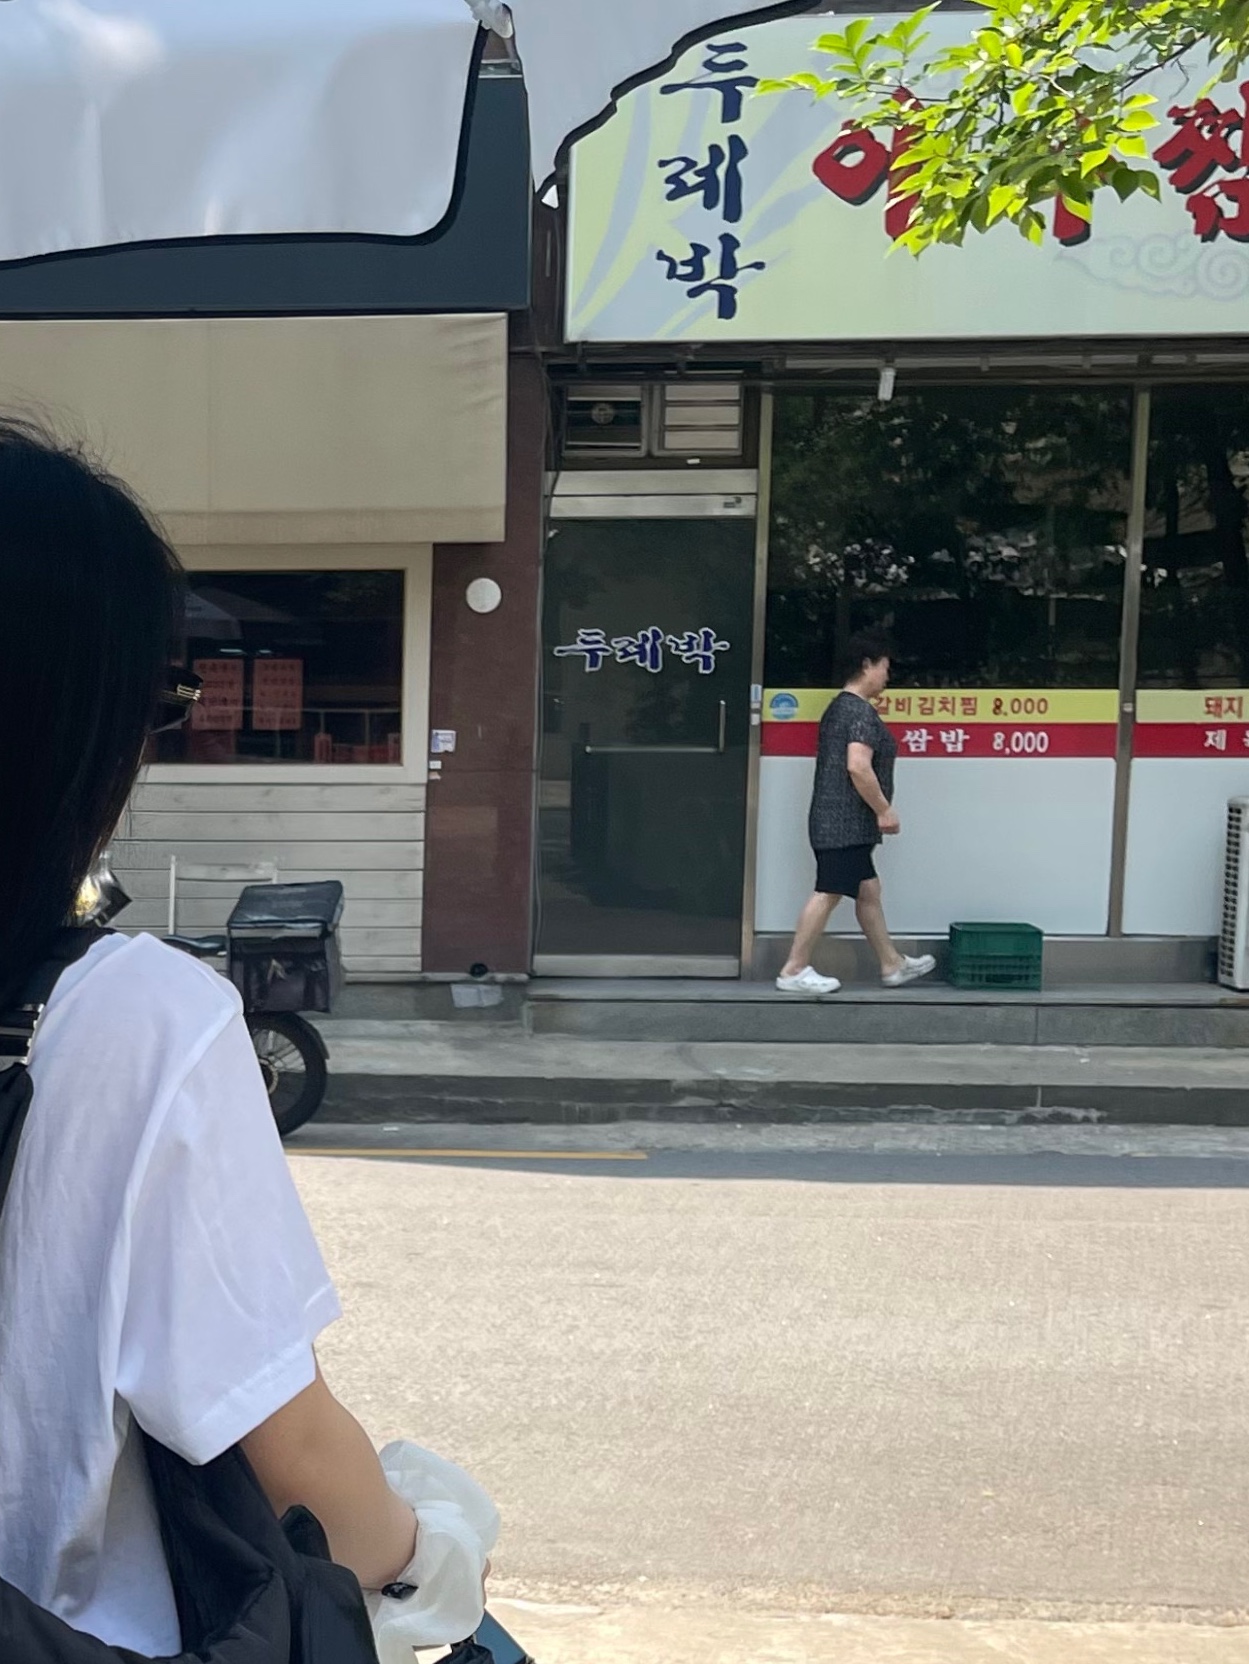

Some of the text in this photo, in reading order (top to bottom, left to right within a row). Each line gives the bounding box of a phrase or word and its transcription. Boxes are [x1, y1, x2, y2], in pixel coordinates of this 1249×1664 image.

[656, 42, 766, 320] 두레박
[553, 626, 731, 674] 두레박
[992, 731, 1049, 755] 8,000
